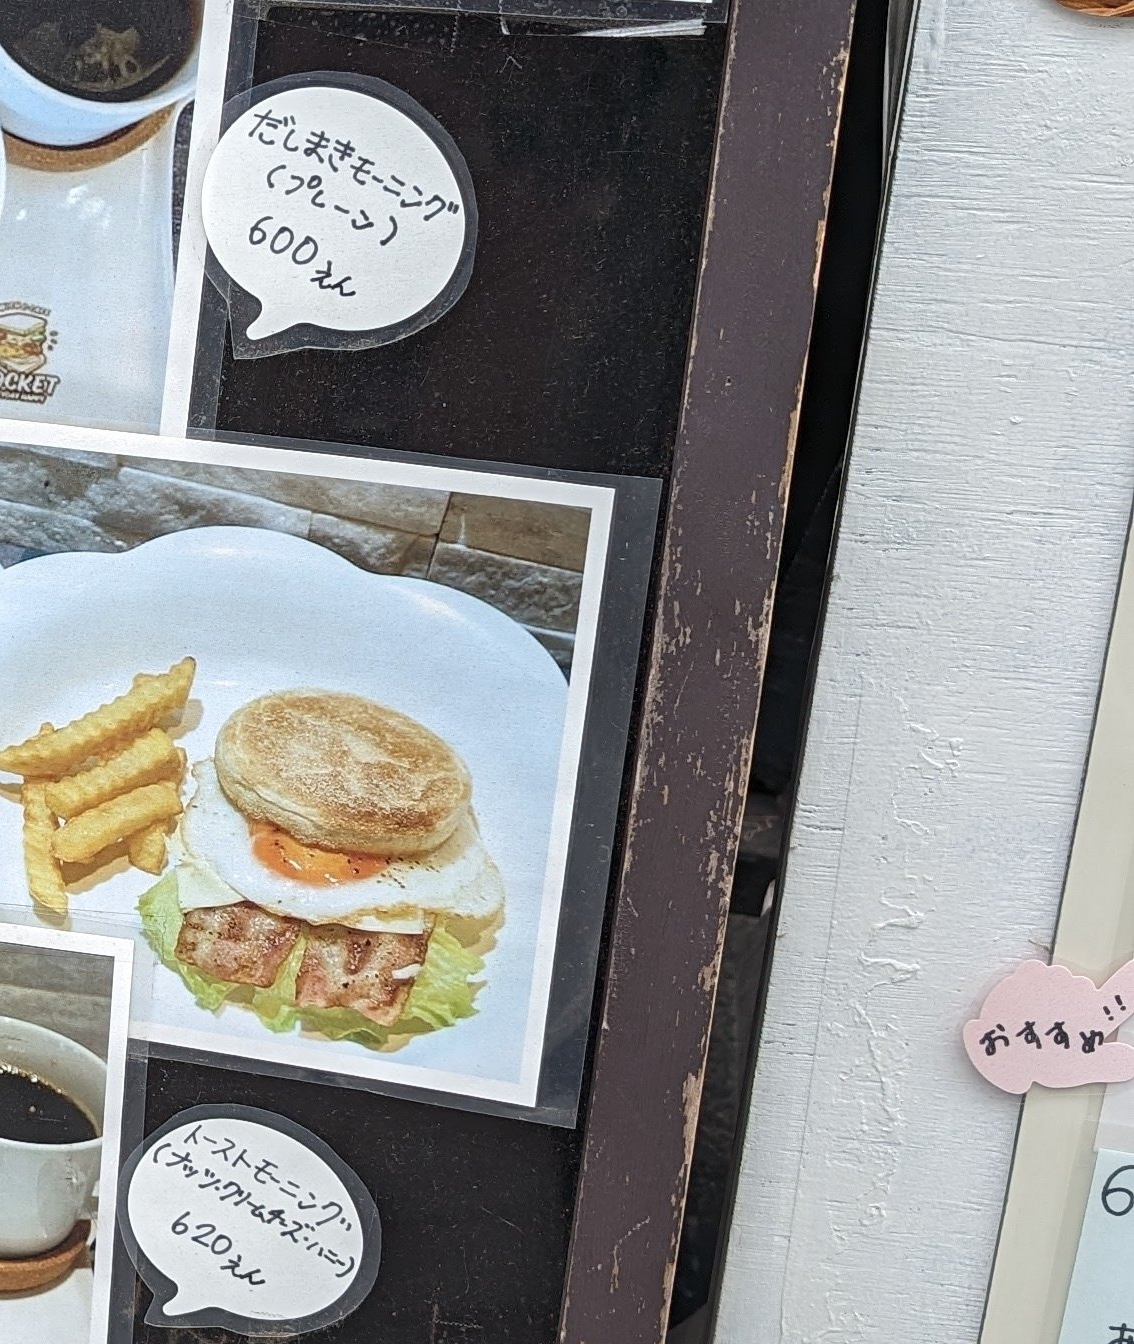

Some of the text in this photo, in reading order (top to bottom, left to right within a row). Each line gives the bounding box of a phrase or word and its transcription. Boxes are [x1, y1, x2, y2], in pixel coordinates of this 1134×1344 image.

[248, 109, 460, 221] だしまきモーニング
[248, 216, 357, 297] 600えん
[183, 1124, 353, 1232] トーストモーニング
[171, 1211, 266, 1286] 620えん
